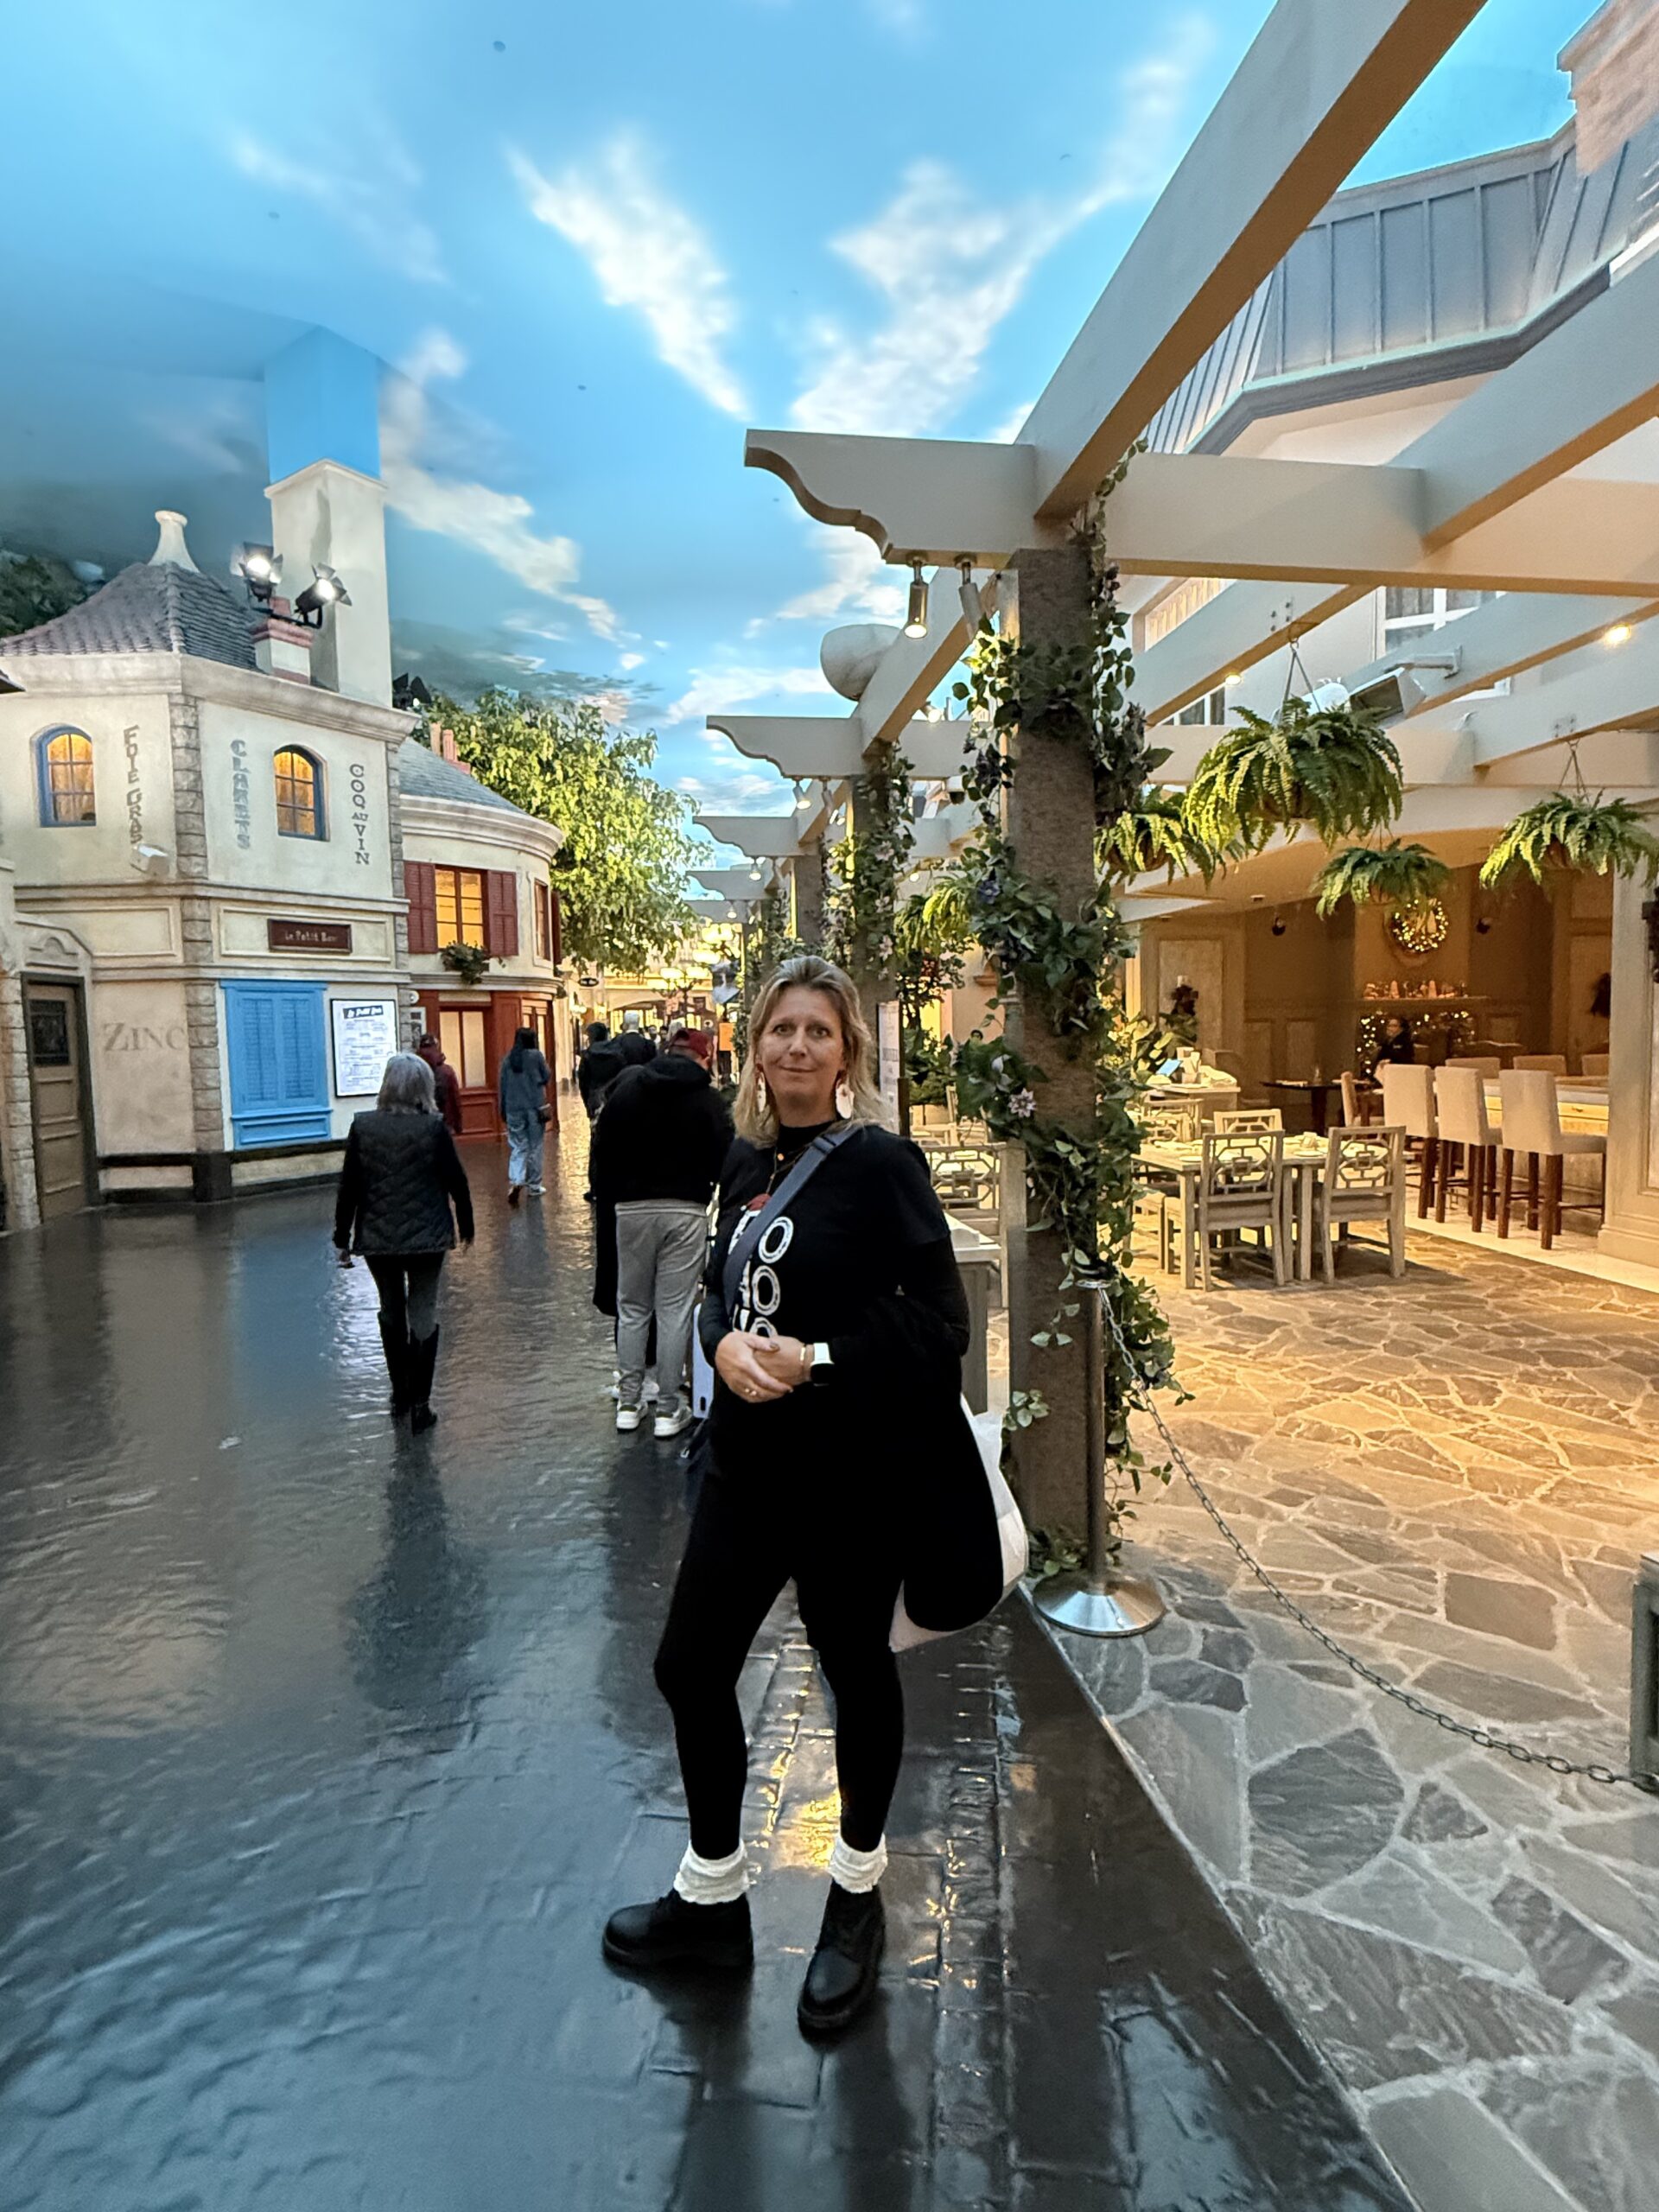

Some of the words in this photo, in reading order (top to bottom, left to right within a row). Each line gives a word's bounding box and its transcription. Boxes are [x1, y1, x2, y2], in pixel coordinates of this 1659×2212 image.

[124, 725, 139, 784] FOIE
[349, 764, 365, 810] COQ
[126, 788, 143, 844] GRAS
[353, 823, 370, 865] VIN
[102, 1022, 187, 1051] ZINC
